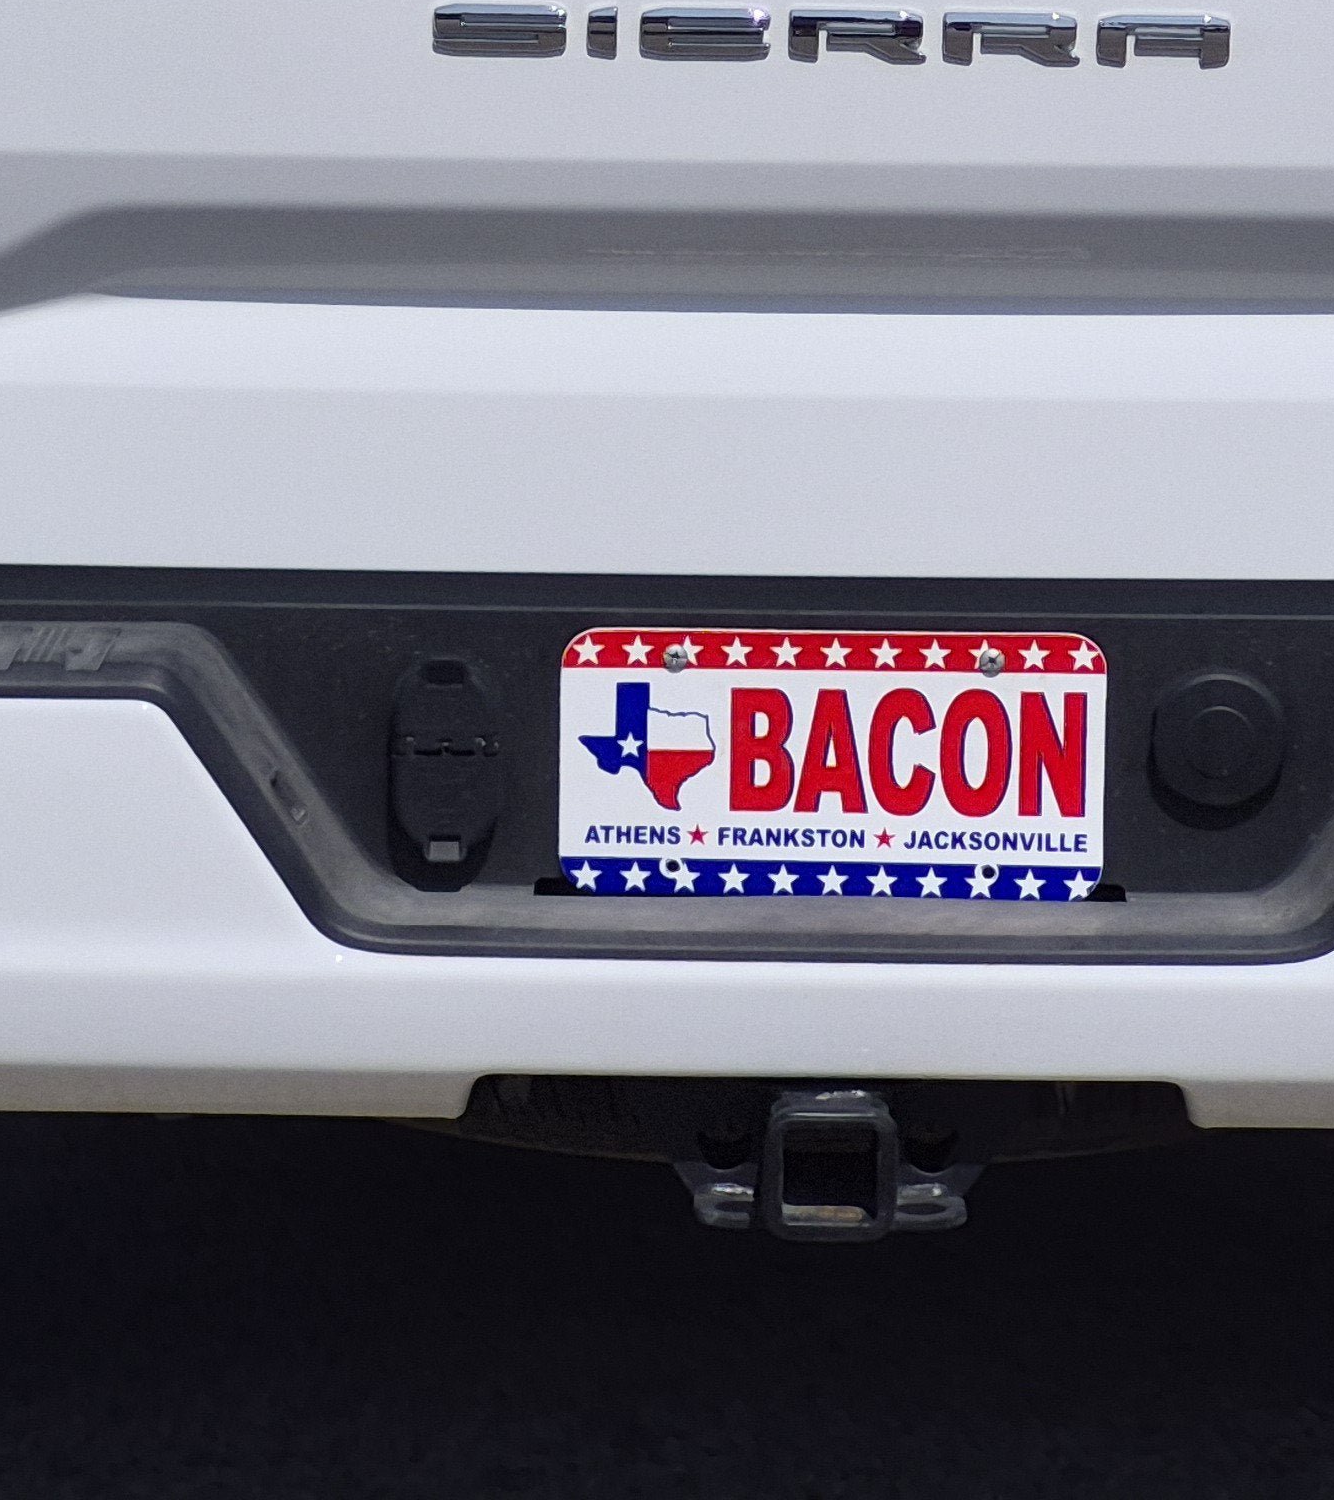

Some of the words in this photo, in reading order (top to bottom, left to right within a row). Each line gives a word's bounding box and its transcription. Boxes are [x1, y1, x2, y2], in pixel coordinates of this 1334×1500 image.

[432, 4, 1231, 69] SIERRA
[729, 687, 1088, 818] BACON
[584, 824, 681, 846] ATHENS
[717, 827, 866, 849] FRANKSTON
[903, 830, 1088, 853] JACKSONVILLE
